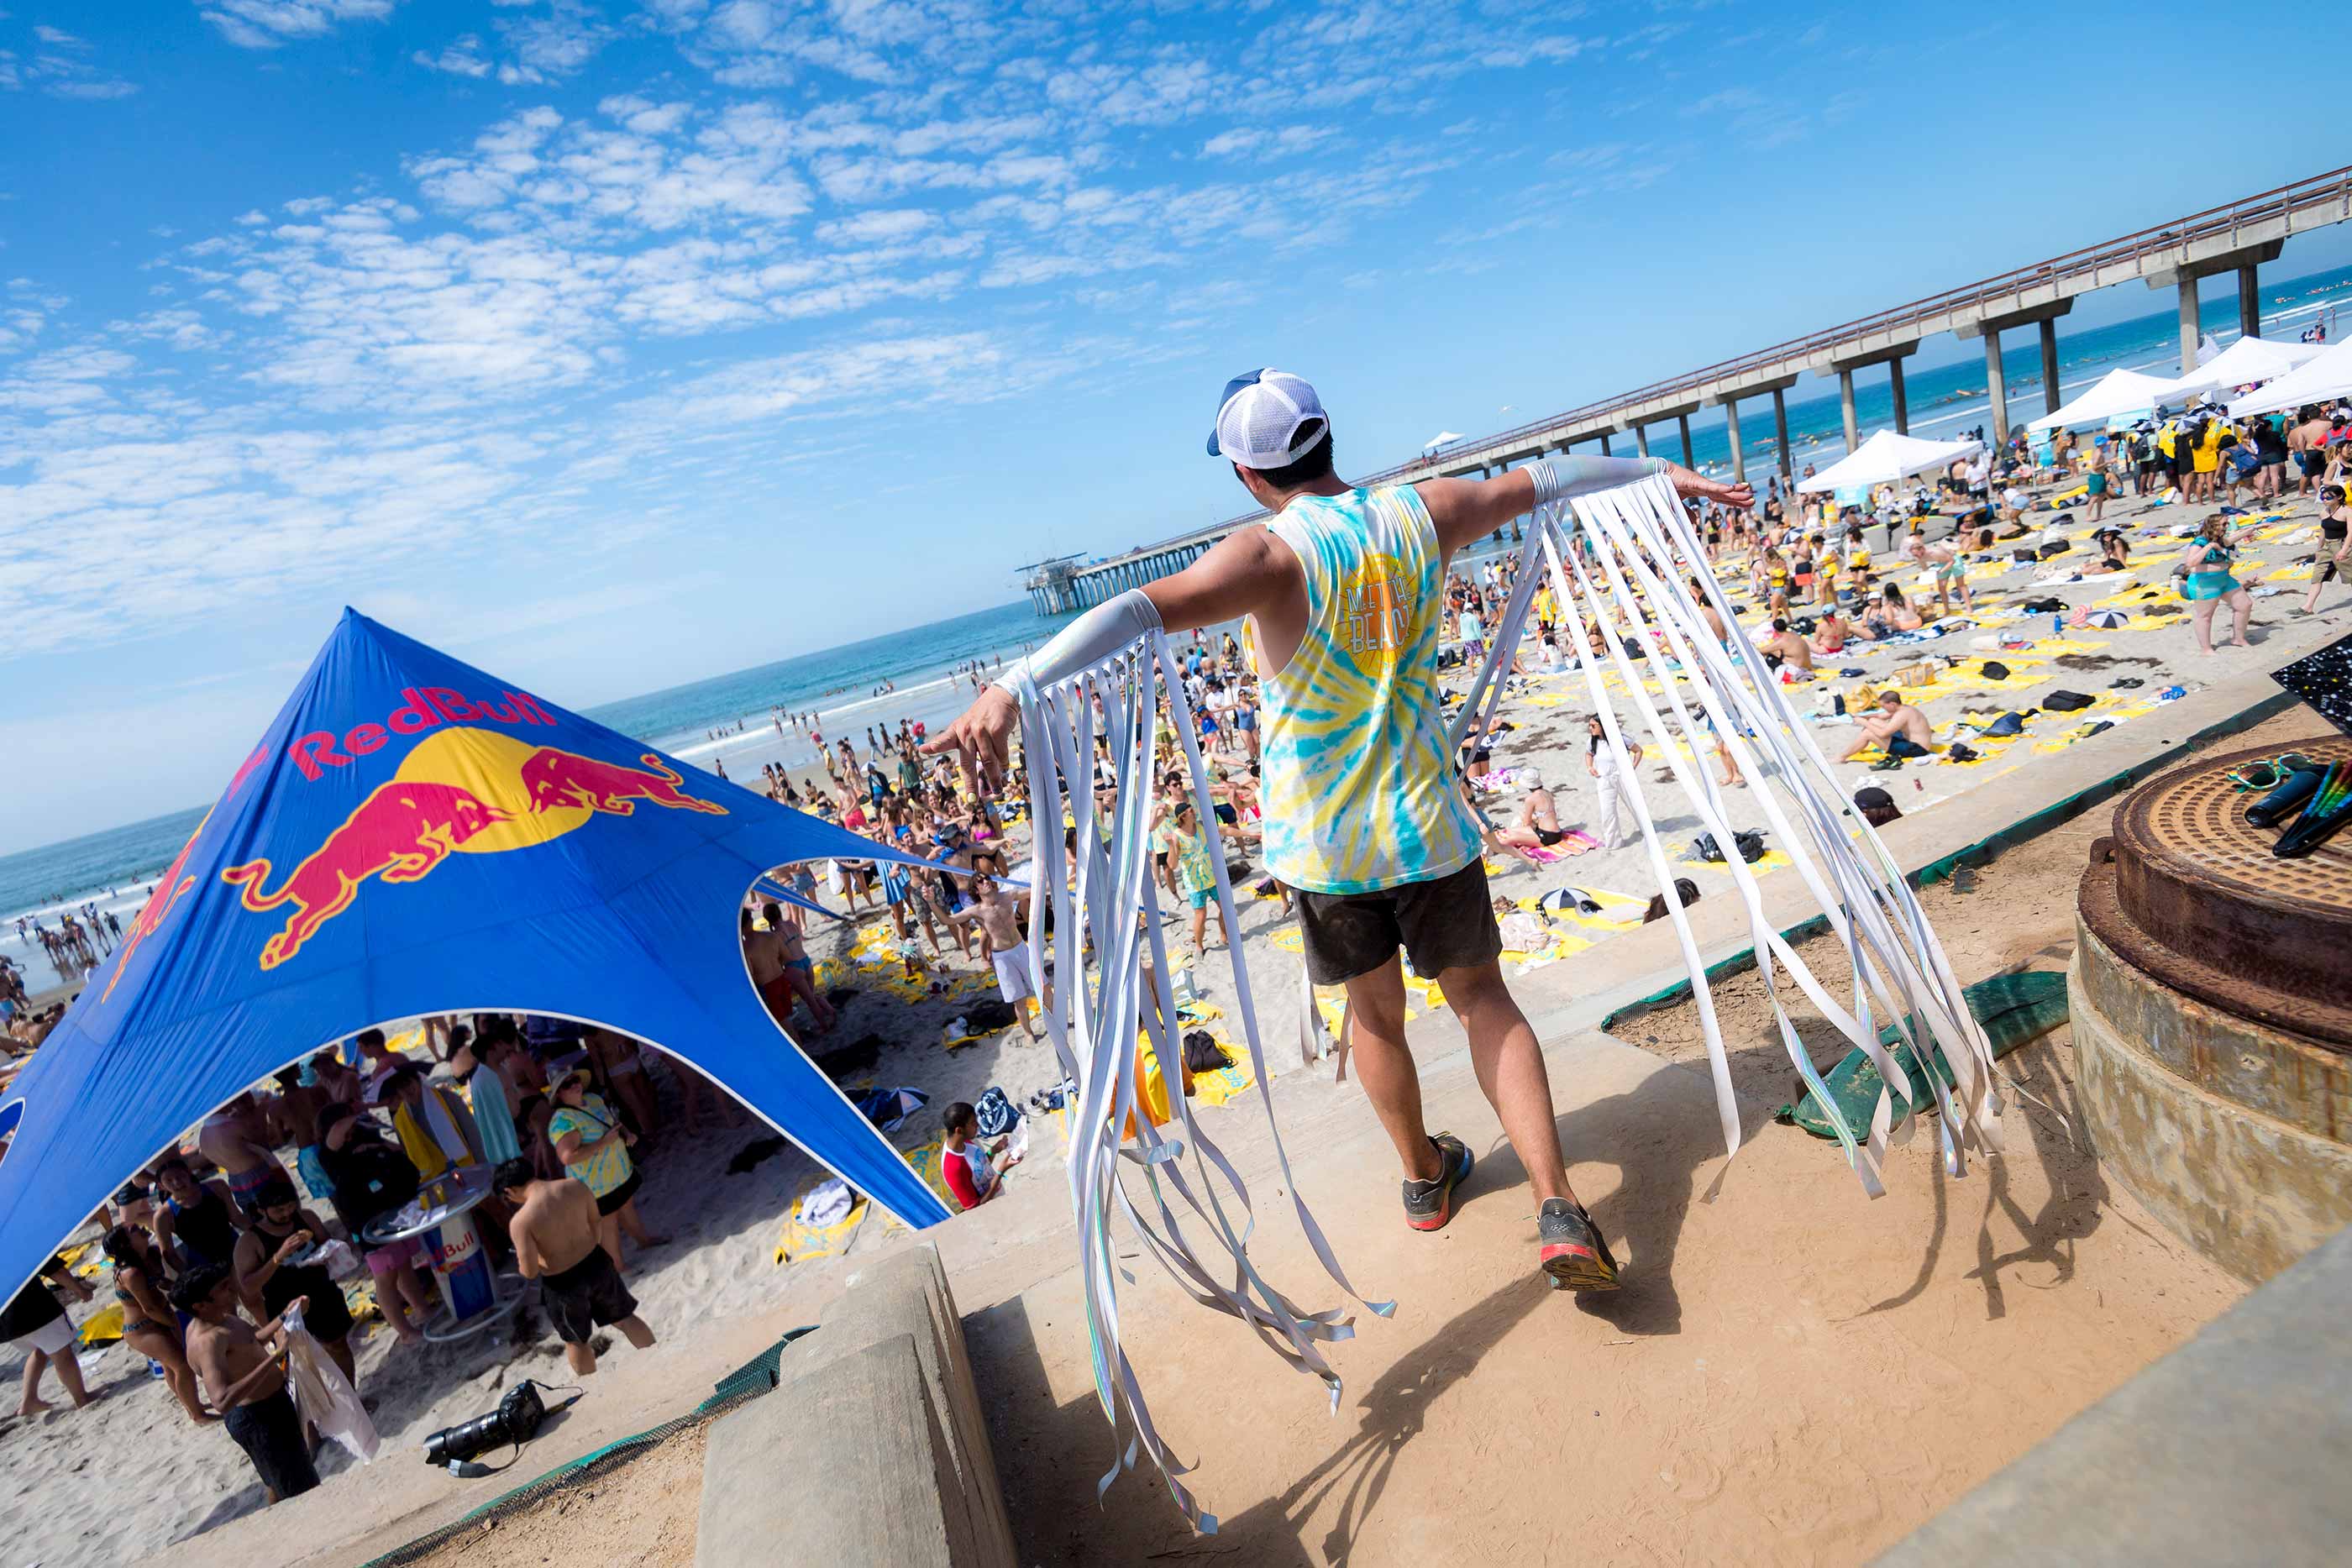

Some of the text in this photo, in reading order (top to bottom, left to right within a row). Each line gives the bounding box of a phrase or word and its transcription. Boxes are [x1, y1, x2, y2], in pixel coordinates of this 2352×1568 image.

[288, 687, 442, 782] Red
[418, 687, 558, 726] Bull
[443, 1230, 475, 1259] Bull
